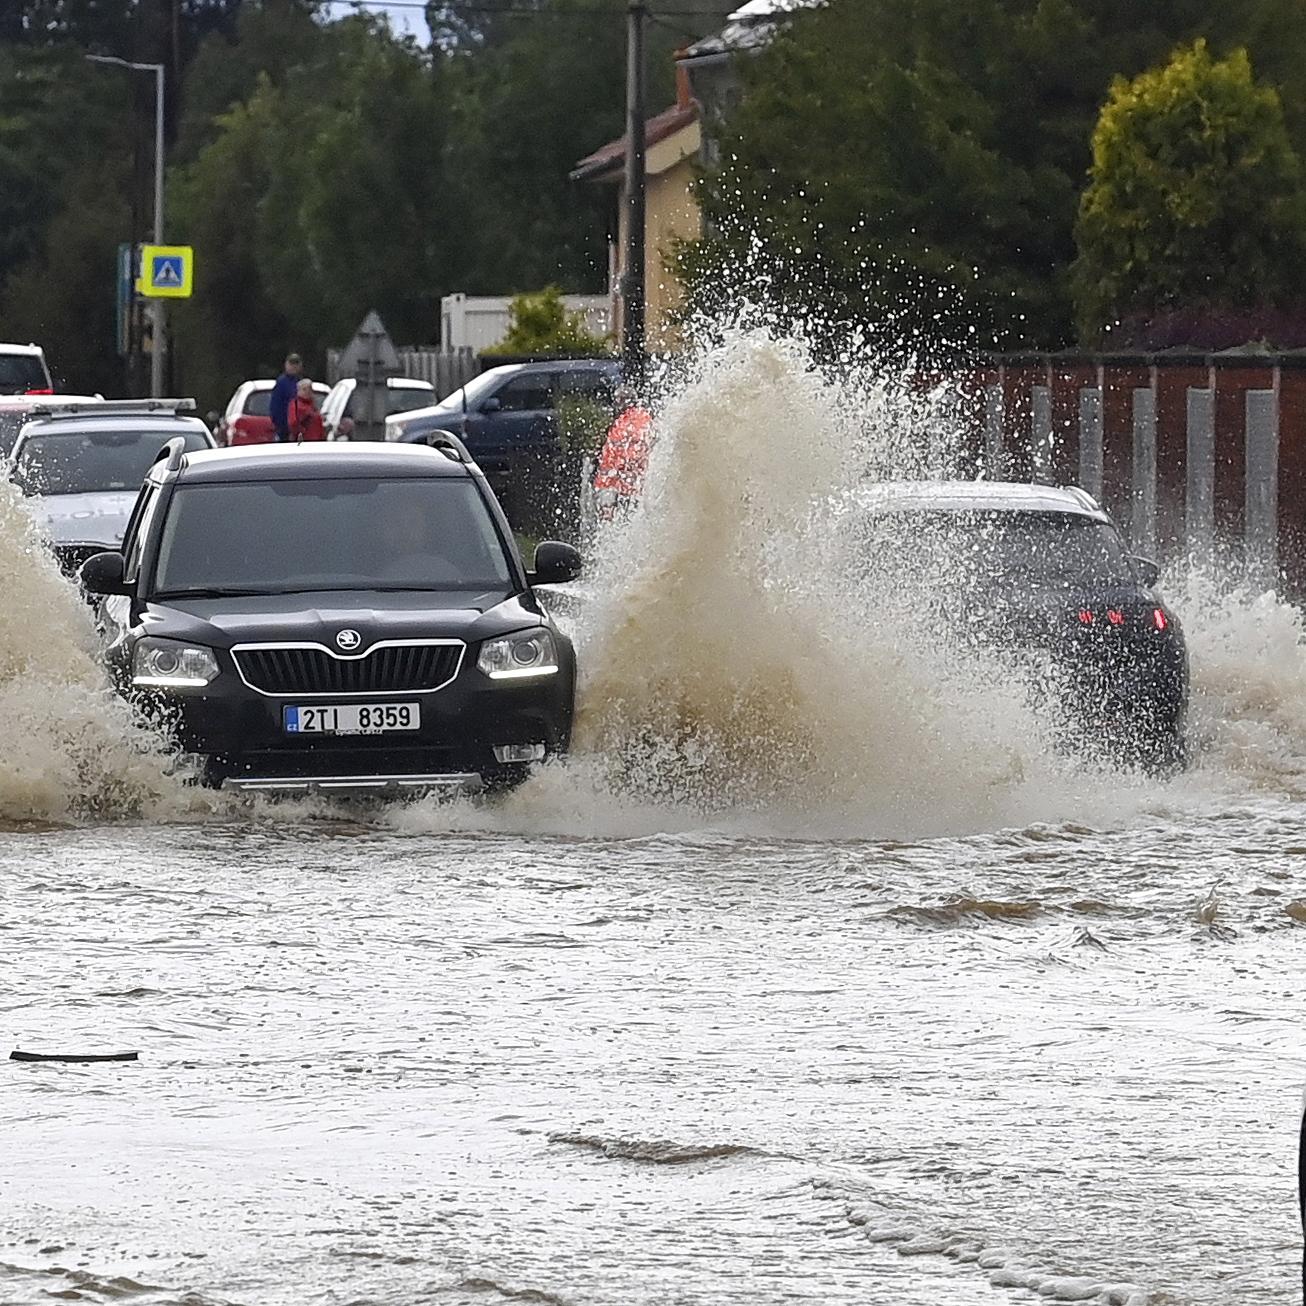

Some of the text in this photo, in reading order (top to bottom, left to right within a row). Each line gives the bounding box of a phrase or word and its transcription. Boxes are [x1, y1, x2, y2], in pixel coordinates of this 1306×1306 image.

[48, 507, 132, 523] POLI
[303, 706, 411, 731] 2TI 8359
[286, 723, 298, 731] CZ
